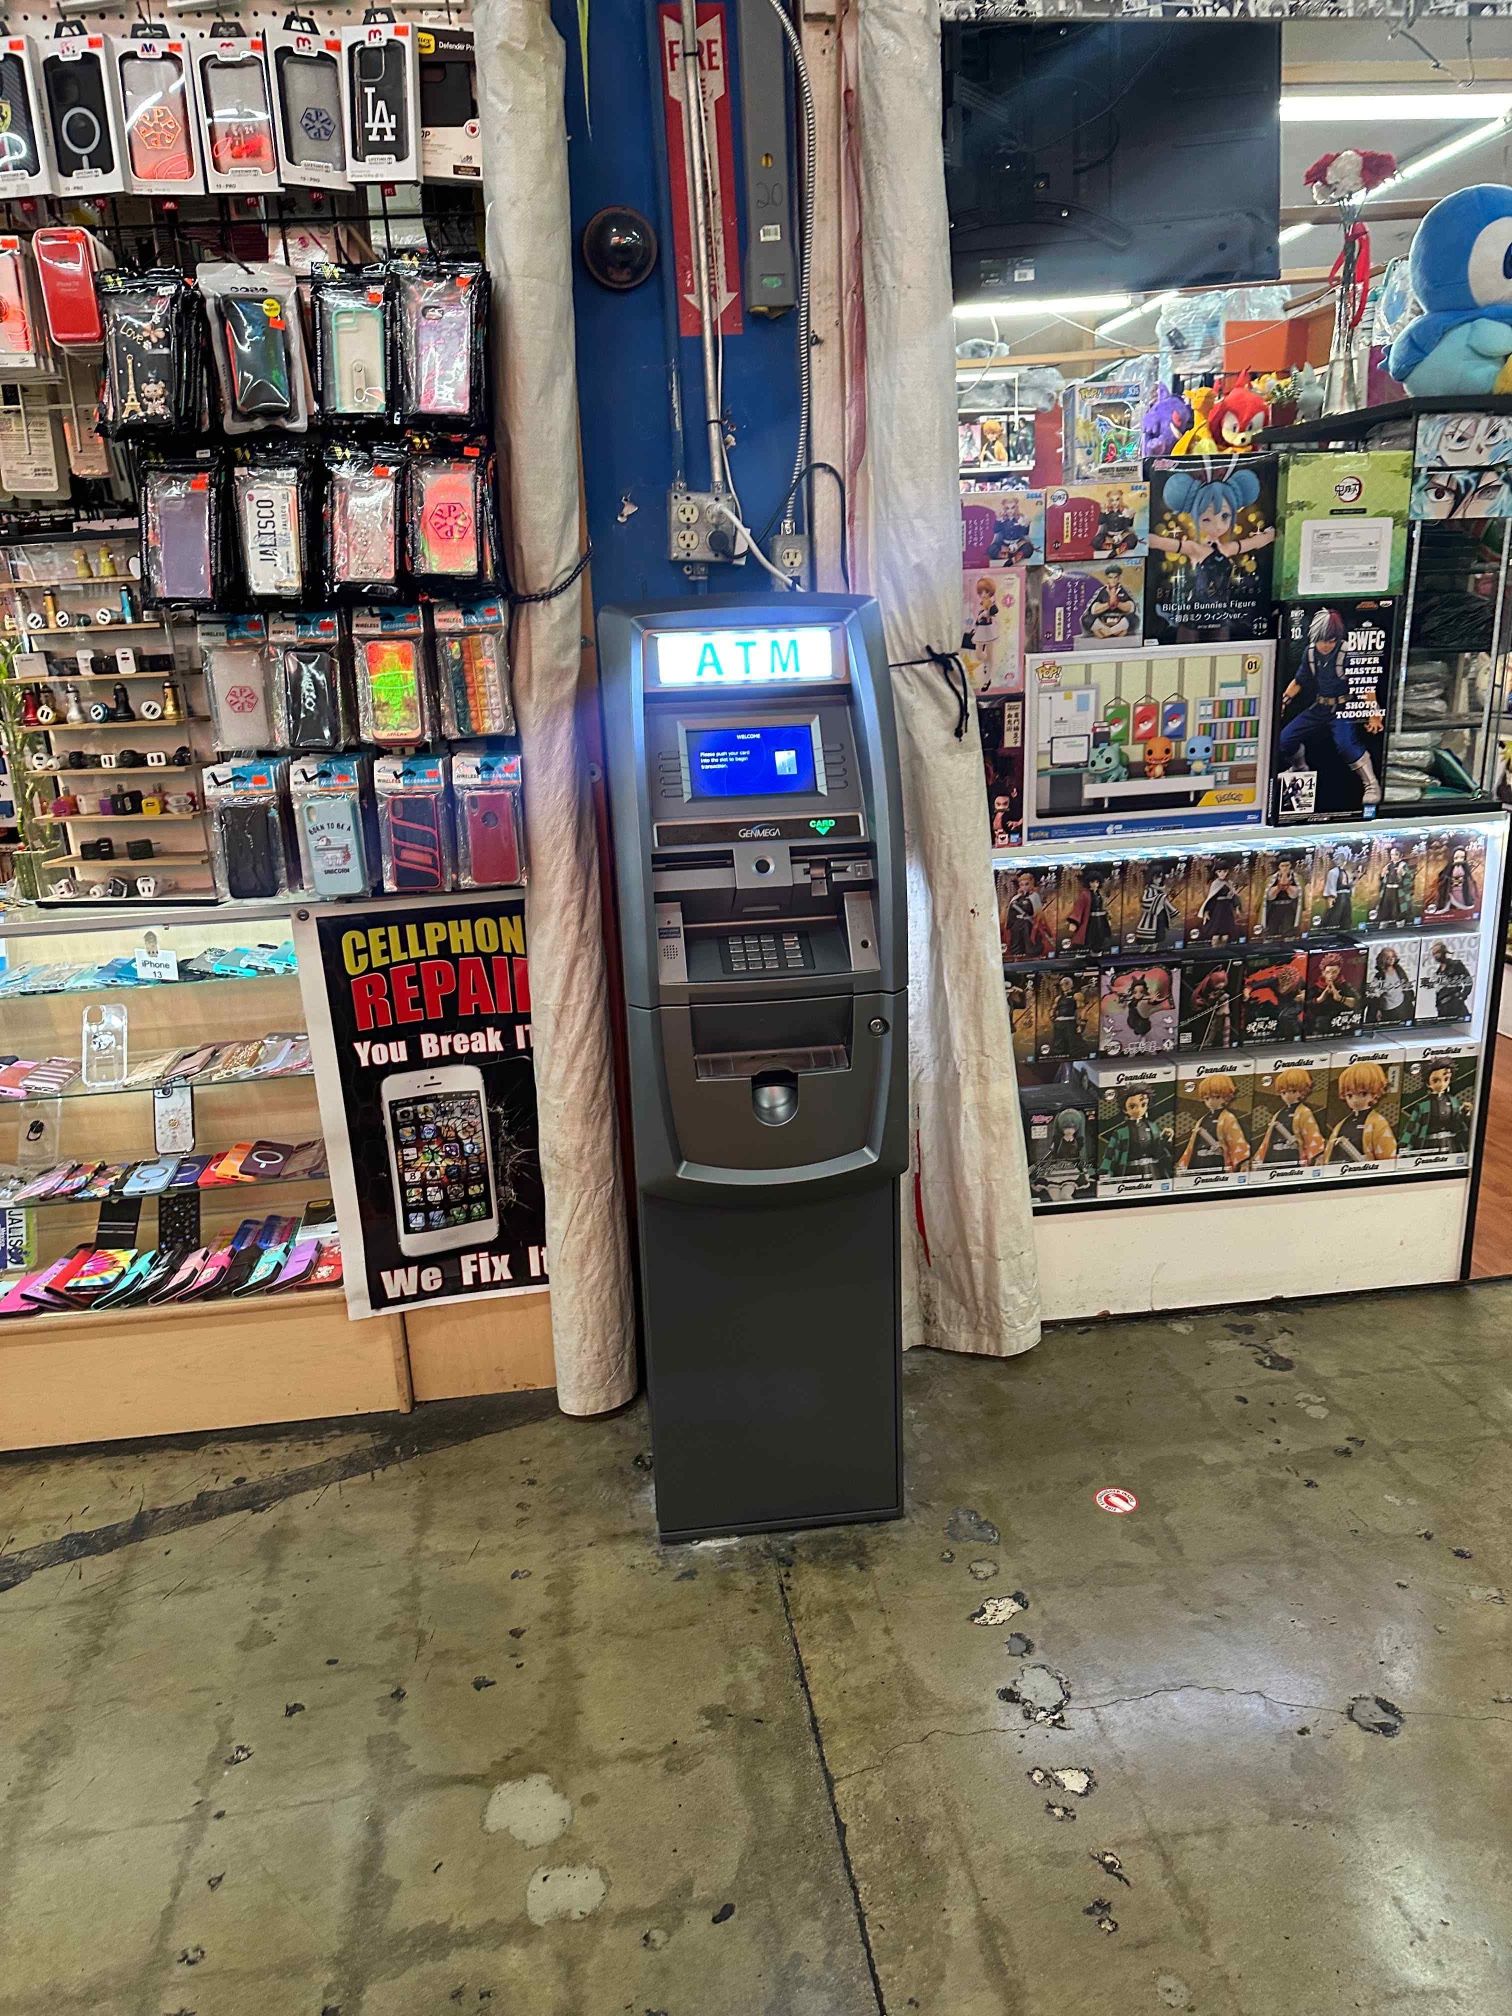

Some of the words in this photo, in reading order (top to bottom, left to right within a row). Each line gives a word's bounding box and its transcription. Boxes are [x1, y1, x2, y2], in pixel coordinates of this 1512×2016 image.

[438, 41, 465, 50] Defender
[668, 39, 720, 72] FRE
[256, 499, 278, 567] JALISCO
[1162, 603, 1191, 611] BiCute
[1194, 601, 1227, 610] Bunnies
[1230, 600, 1257, 609] Figure
[1347, 630, 1386, 652] BWFC
[696, 639, 800, 677] ATM
[1349, 657, 1380, 666] SUPER
[1247, 660, 1258, 671] 01
[1344, 666, 1383, 675] MASTER
[1348, 676, 1379, 685] STARS
[1348, 686, 1376, 695] PIECE
[1345, 701, 1378, 710] SHOTO
[1335, 709, 1386, 719] TODOROKI
[809, 819, 836, 828] CARD
[308, 824, 324, 835] BORN
[738, 827, 781, 838] GENMEGA
[141, 960, 170, 969] iPhone
[153, 971, 163, 979] 13
[353, 1039, 408, 1067] You
[420, 1026, 505, 1059] Break
[1423, 1046, 1462, 1058] Grandista
[1273, 1058, 1314, 1071] Grandista
[1348, 1053, 1389, 1065] Grandista
[1196, 1065, 1237, 1077] Grandista
[1116, 1072, 1157, 1084] Grandista
[1414, 1156, 1448, 1167] Grandista
[1269, 1169, 1304, 1180] Grandista
[1340, 1163, 1380, 1175] Grandista
[1193, 1175, 1229, 1186] Grandista
[1117, 1183, 1153, 1194] Grandista
[8, 1210, 24, 1265] JALIS
[380, 1265, 443, 1299] We
[460, 1251, 513, 1285] Fix
